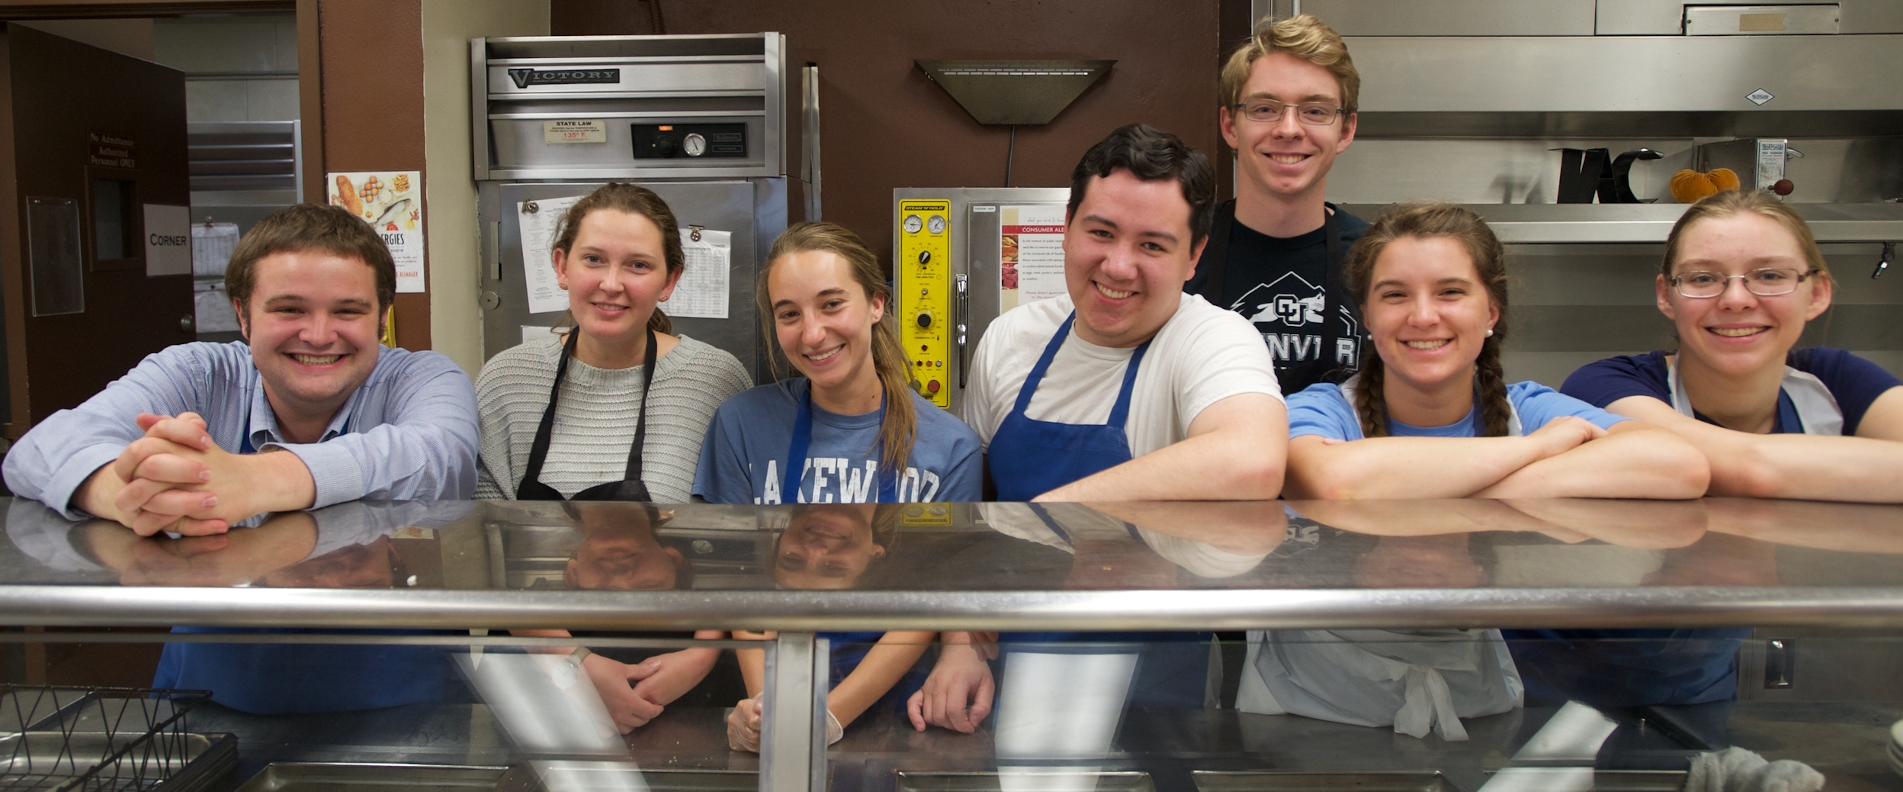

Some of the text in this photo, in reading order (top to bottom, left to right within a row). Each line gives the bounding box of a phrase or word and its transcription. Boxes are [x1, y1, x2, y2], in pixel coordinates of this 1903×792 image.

[509, 69, 617, 87] VICTORY
[90, 132, 100, 142] No
[119, 158, 136, 169] ONLY
[149, 232, 187, 246] CORNER
[1273, 294, 1309, 327] CU
